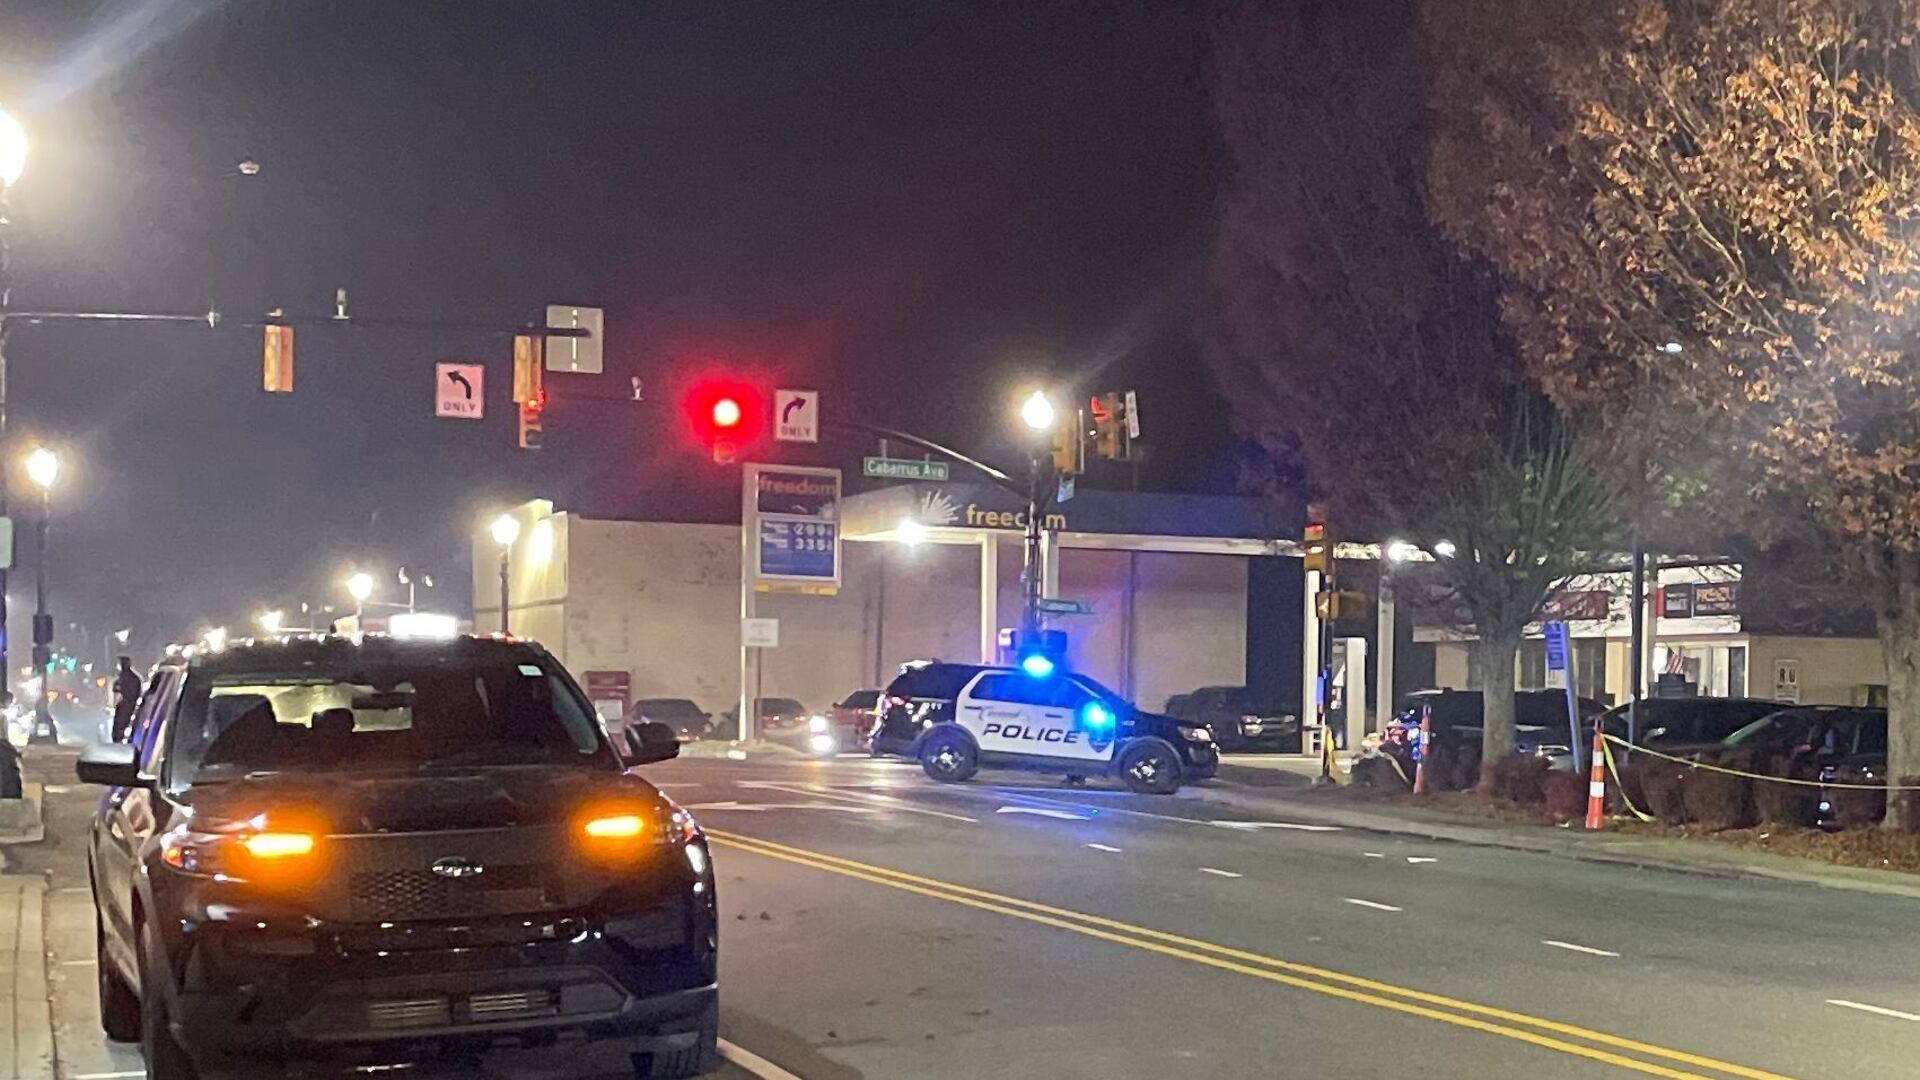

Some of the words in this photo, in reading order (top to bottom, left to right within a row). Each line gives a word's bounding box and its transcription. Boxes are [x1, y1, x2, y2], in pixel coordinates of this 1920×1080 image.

[443, 401, 476, 412] ONLY
[781, 426, 811, 437] ONLY
[867, 460, 920, 476] Cabarrus
[923, 462, 945, 478] Ave
[760, 475, 836, 496] freedom
[965, 503, 1067, 529] freedm
[983, 723, 1081, 744] POLICE
